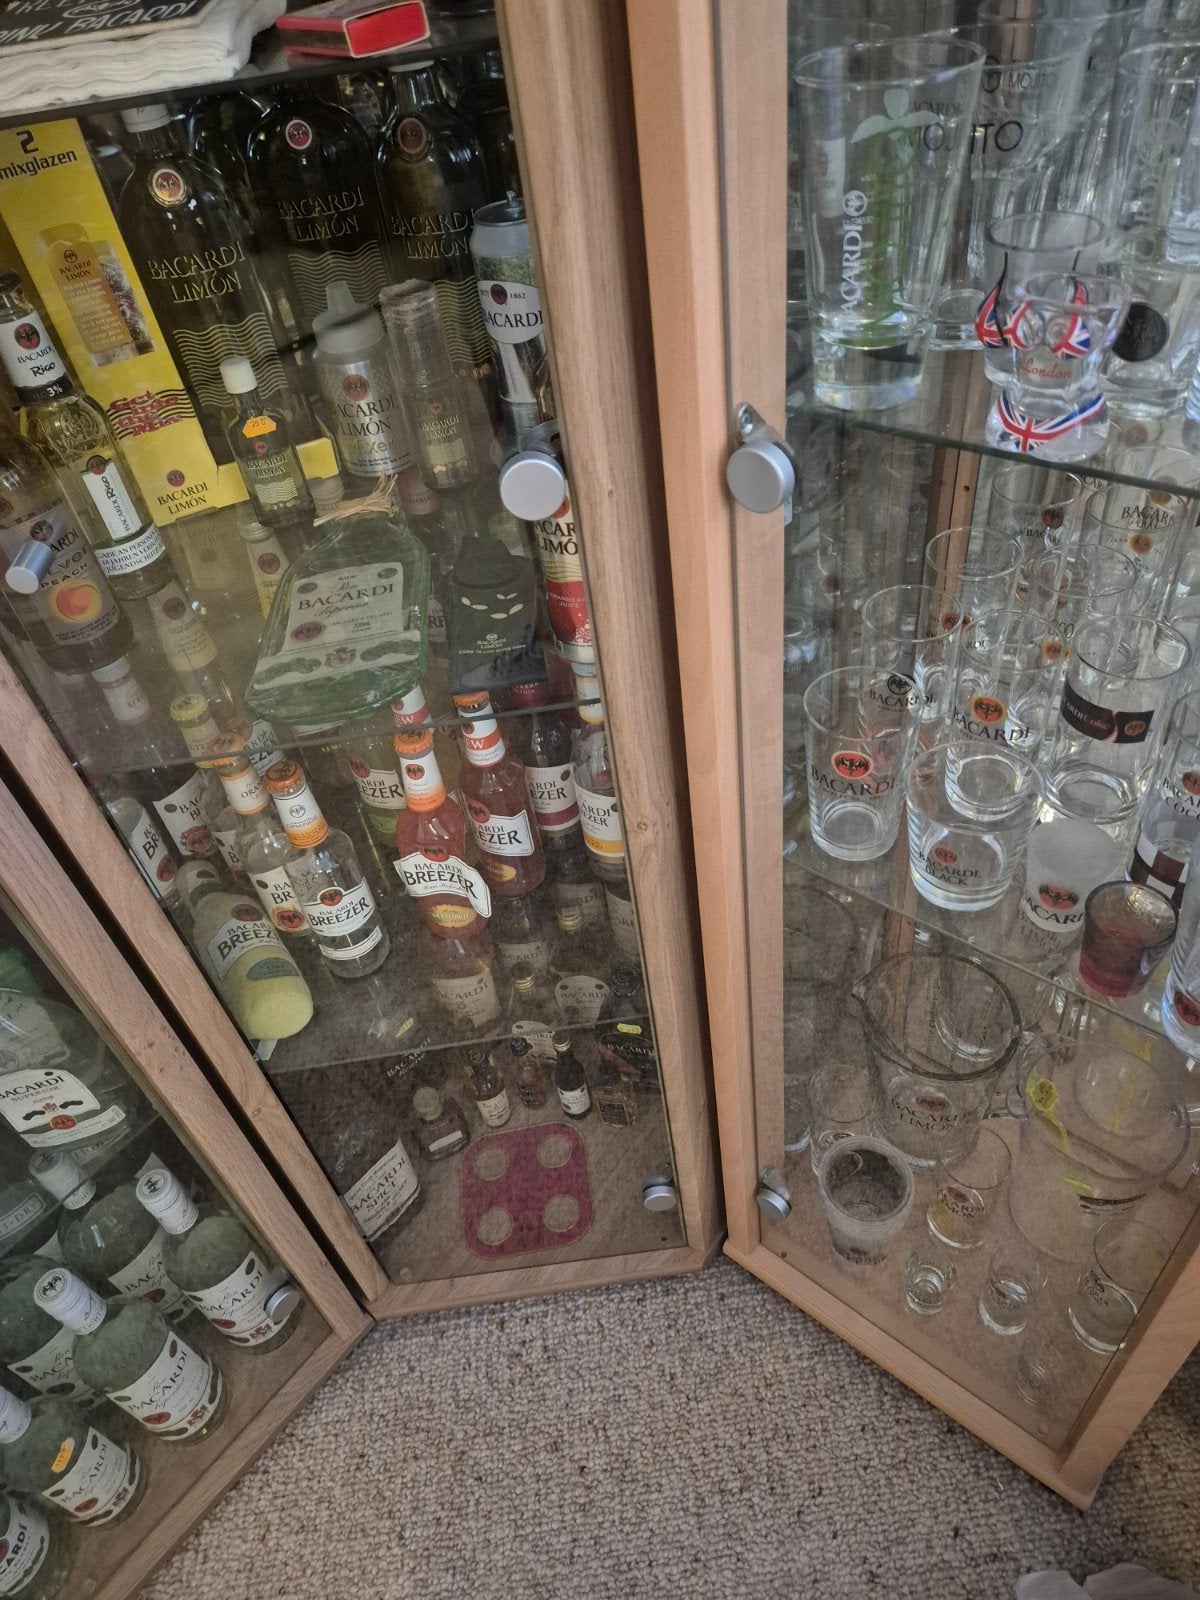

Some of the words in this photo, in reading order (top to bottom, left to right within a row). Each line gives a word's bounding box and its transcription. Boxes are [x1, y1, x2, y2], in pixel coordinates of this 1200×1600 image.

[64, 1, 198, 34] BACARDI
[16, 130, 39, 154] 2
[0, 150, 77, 180] mixglazen
[275, 186, 366, 220] BACARDI
[148, 240, 246, 280] BACARDI
[841, 224, 863, 316] ACARDI
[1021, 357, 1072, 380] London
[46, 384, 63, 397] 3%
[331, 394, 398, 418] ACARDI
[340, 417, 392, 437] LIMÓN
[157, 481, 210, 506] BACARDI
[50, 528, 79, 553] ARDI
[535, 520, 576, 537] ACAR
[537, 537, 579, 556] LIMÓ
[41, 563, 88, 589] PEACH
[298, 583, 395, 611] BACARDI
[1066, 701, 1084, 720] ARDI
[952, 706, 1030, 742] BACARDI
[464, 737, 484, 750] EW
[240, 781, 262, 800] ORAN
[361, 779, 386, 788] ARDI
[361, 784, 405, 799] EZER
[529, 780, 556, 791] ARDI
[811, 764, 896, 796] BACARDI
[530, 787, 567, 800] EZER
[582, 802, 611, 817] ARDI
[582, 811, 609, 827] EZER
[477, 830, 523, 845] EZER
[478, 824, 505, 833] ARDI
[414, 862, 463, 875] BACARDI
[403, 870, 479, 900] BREEZER
[307, 896, 370, 927] BREEZER
[1026, 897, 1085, 925] ACAR
[227, 921, 268, 936] BACAR
[216, 929, 280, 962] BREEZ
[441, 981, 488, 1001] ACARDI
[350, 1157, 406, 1214] BACARDI
[125, 1260, 163, 1293] BACA
[200, 1270, 263, 1312] BACARDI
[29, 1356, 73, 1382] BACA
[128, 1350, 187, 1411] BACARDI
